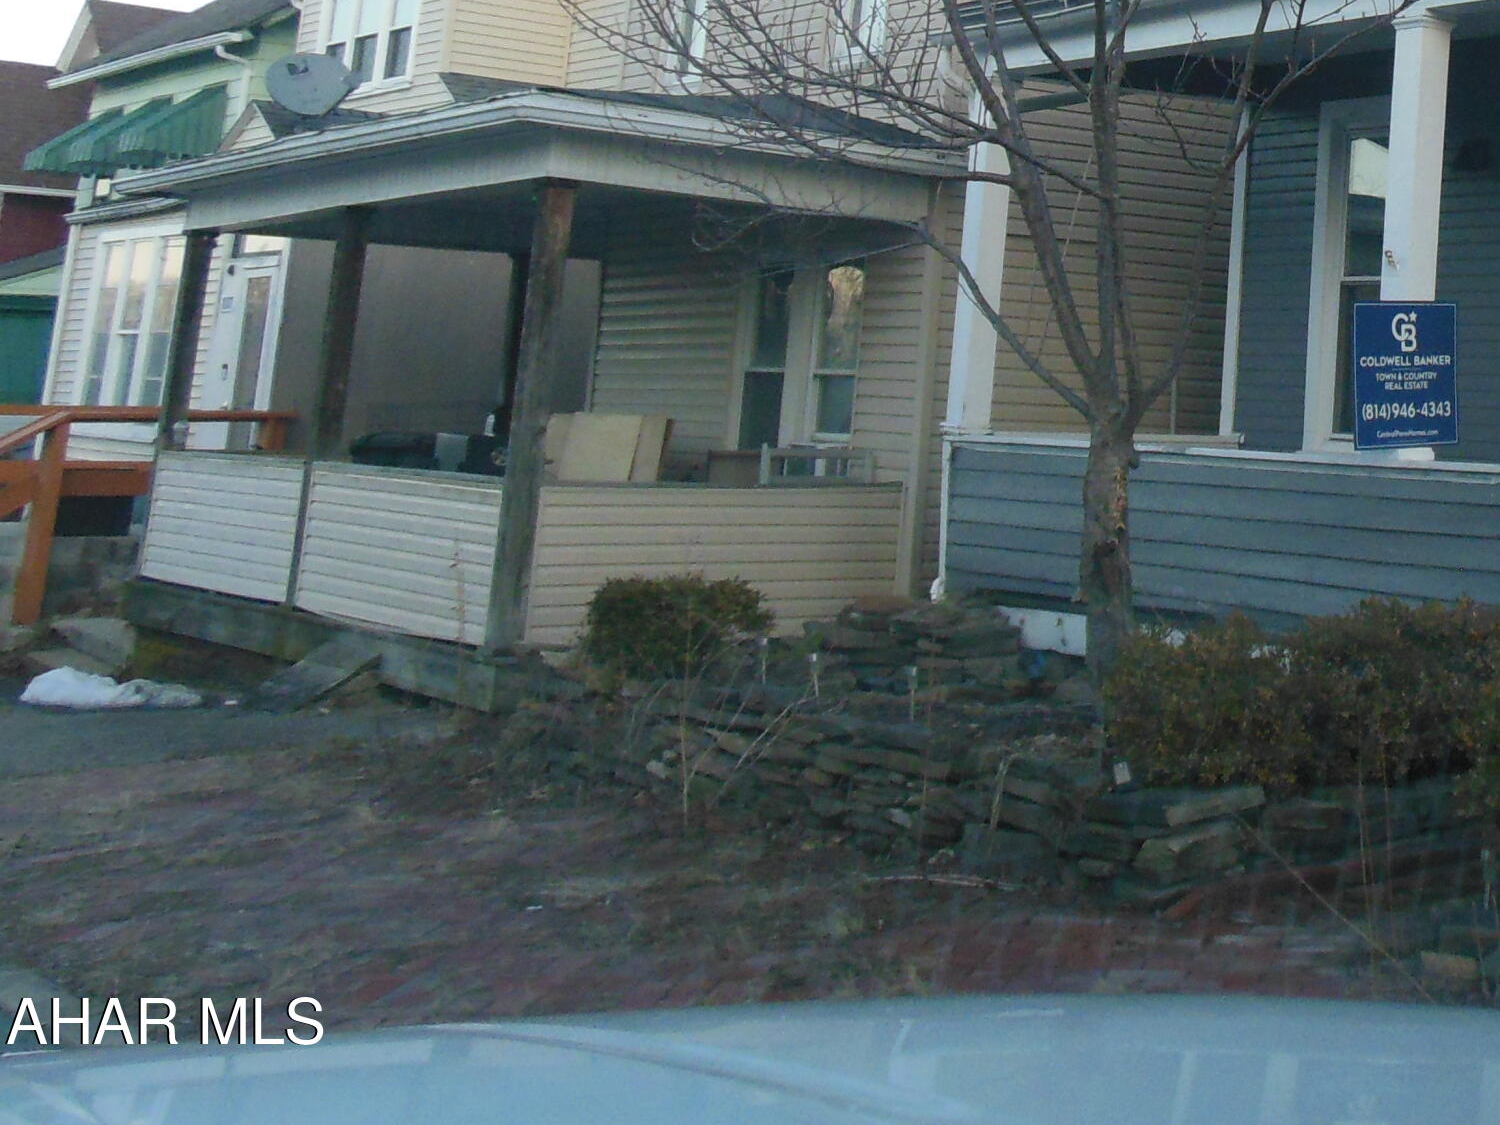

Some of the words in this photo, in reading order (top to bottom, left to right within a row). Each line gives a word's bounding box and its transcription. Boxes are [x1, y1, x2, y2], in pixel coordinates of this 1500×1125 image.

[1360, 356, 1411, 367] COLDWELL
[1413, 355, 1451, 366] BANKER
[1375, 372, 1397, 381] TOWN
[1398, 372, 1402, 380] &
[1403, 371, 1437, 380] COUNTRY
[1384, 382, 1403, 390] REAL
[1404, 381, 1428, 390] ESTATE
